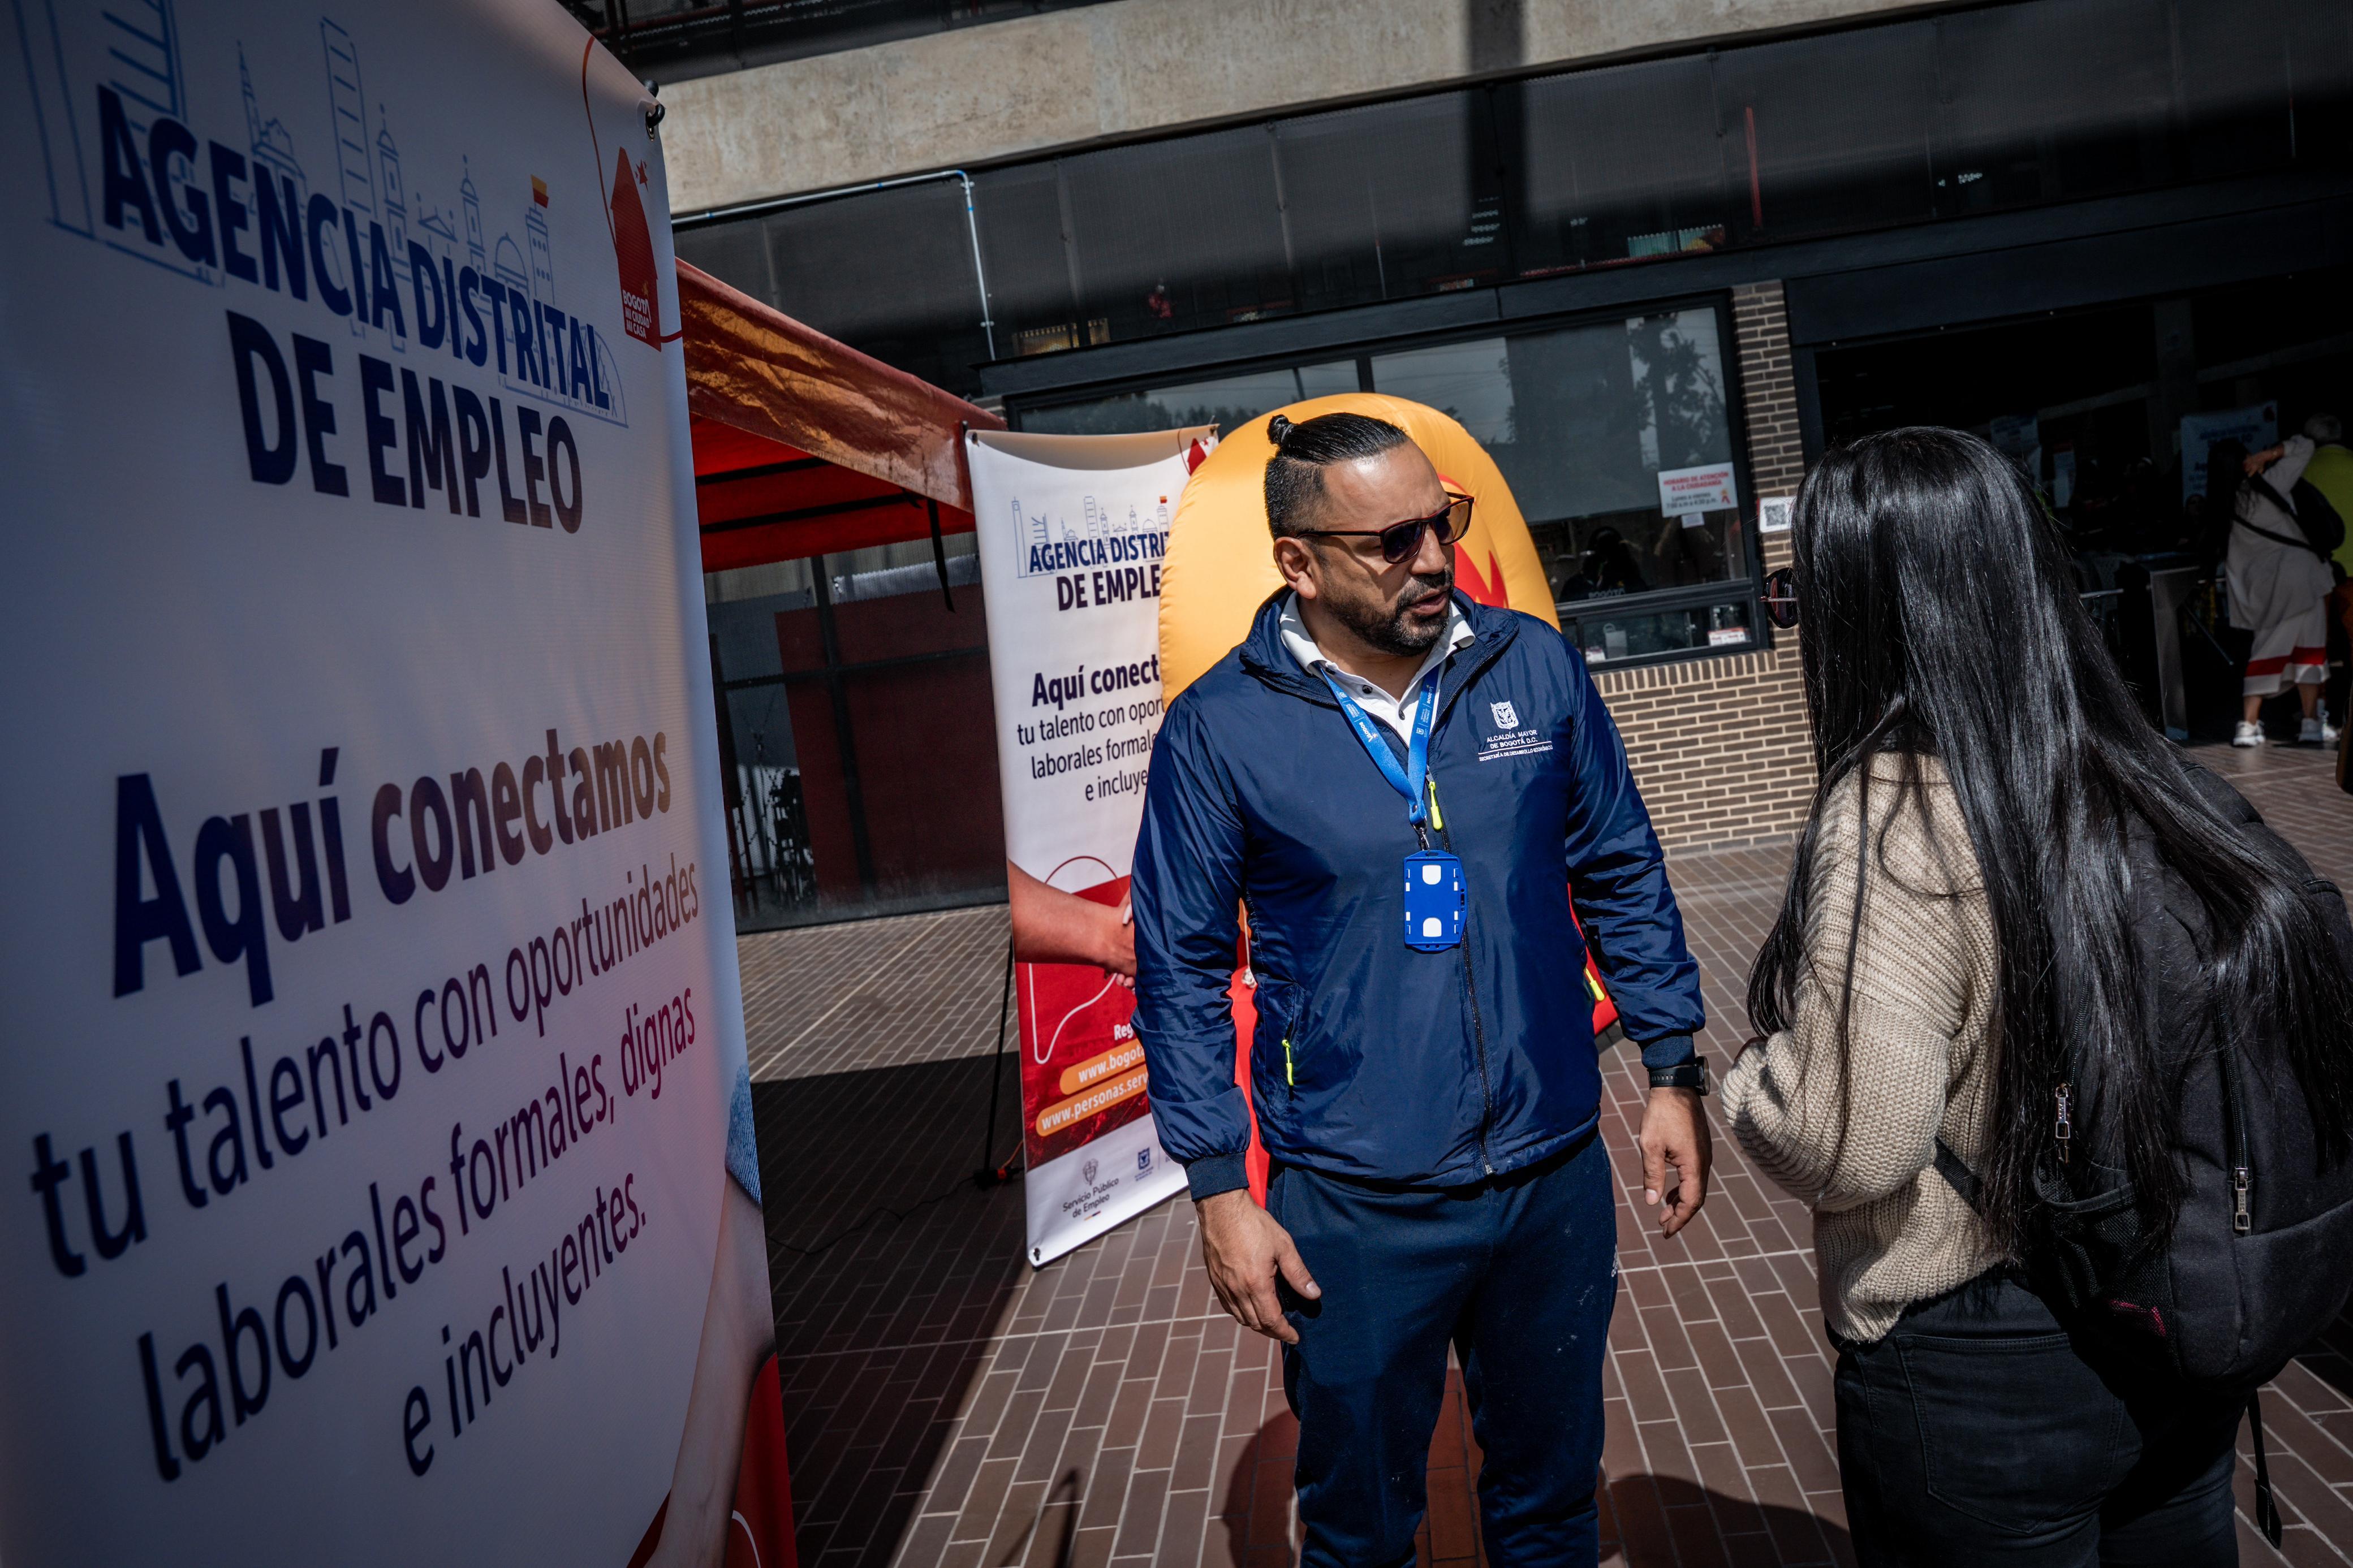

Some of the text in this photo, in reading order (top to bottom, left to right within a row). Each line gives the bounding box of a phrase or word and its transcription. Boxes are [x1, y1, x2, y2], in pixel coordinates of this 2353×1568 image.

[97, 84, 610, 411] AGENCIA DISTRITAL
[625, 306, 650, 329] MI CIUDAD
[626, 319, 647, 339] MI CASA
[226, 310, 583, 534] DE EMPLEO
[1029, 538, 1108, 573] AGENCIA
[1056, 574, 1088, 611] DE
[1032, 654, 1160, 711] Aquí conect
[1017, 724, 1035, 746] tu
[1039, 711, 1094, 741] talento
[1098, 706, 1125, 728] con
[1486, 729, 1537, 743] ALCALDÍA MAYOR
[1499, 736, 1525, 748] BOGOTÁ
[1031, 744, 1102, 779] laborales
[1479, 751, 1503, 762] SECRETARÍA
[1085, 784, 1094, 801] e
[113, 728, 672, 1008] Aquí conectamos
[1114, 1022, 1134, 1040] Reg
[30, 853, 699, 1278] tu talento con oportunidades
[1062, 1178, 1119, 1212] Servicio Público
[1072, 1194, 1110, 1218] de Empleo
[136, 987, 696, 1483] laborales formales, dignas
[402, 1170, 647, 1478] e incluyentes.
